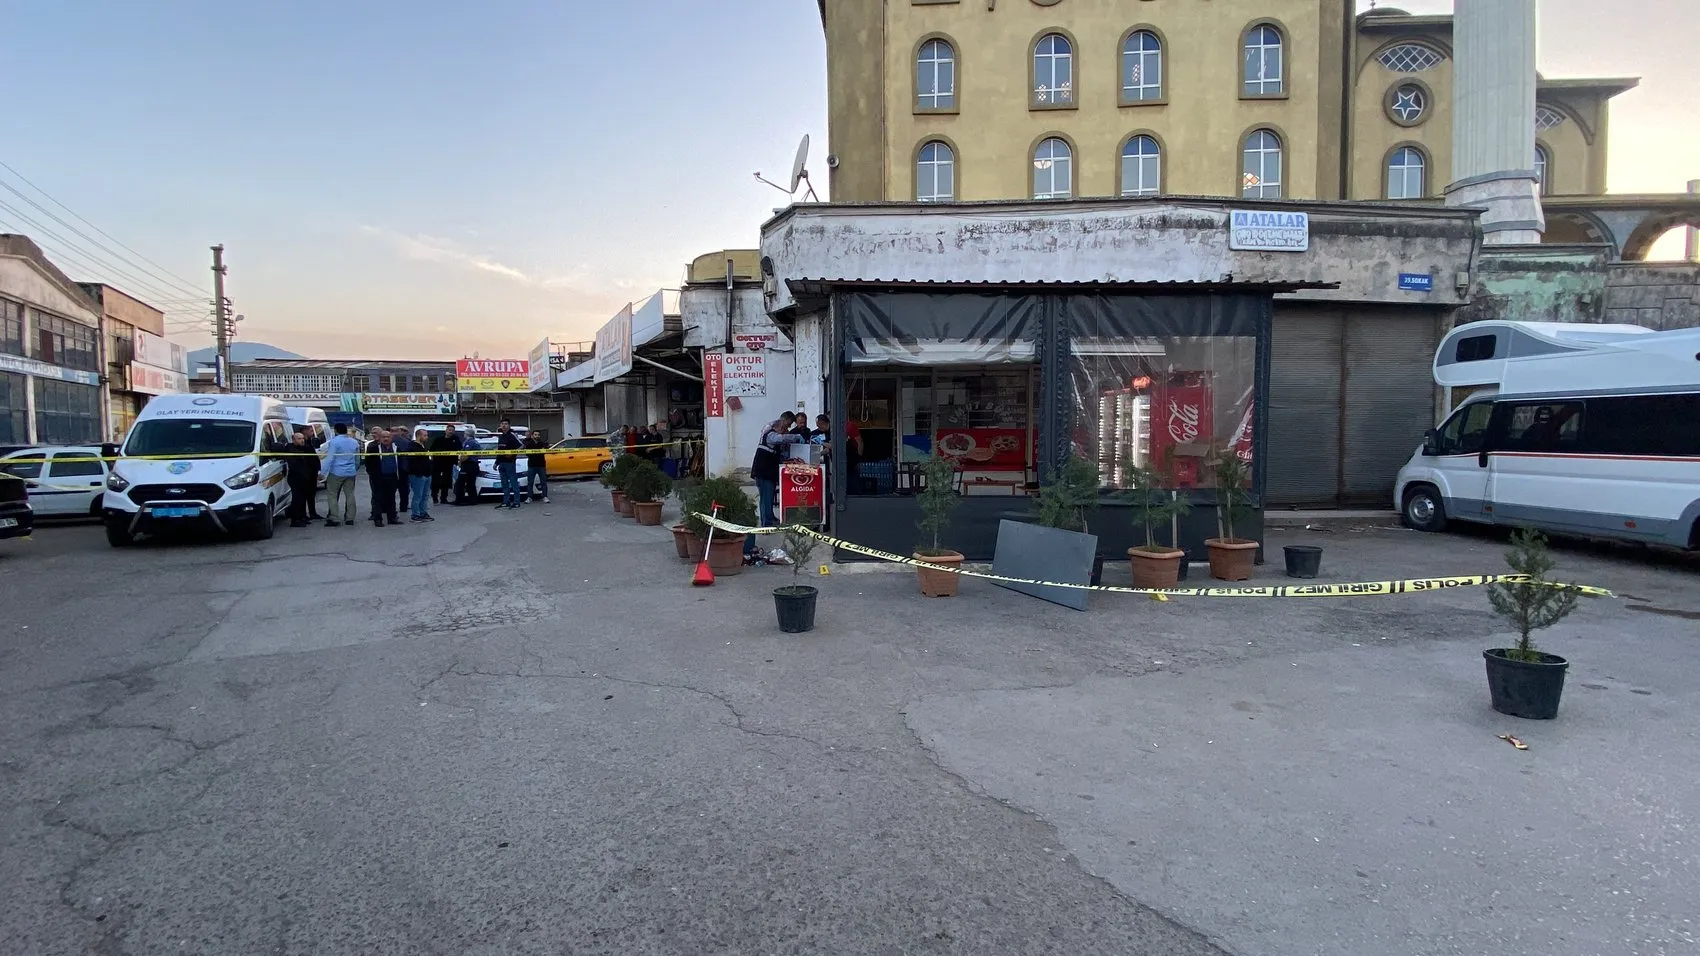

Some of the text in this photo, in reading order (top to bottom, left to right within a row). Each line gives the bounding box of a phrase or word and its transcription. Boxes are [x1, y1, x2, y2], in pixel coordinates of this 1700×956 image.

[1249, 213, 1305, 228] ATALAR
[465, 361, 524, 372] AVRUPA
[726, 356, 762, 364] OKTUR
[1168, 400, 1199, 443] Cola
